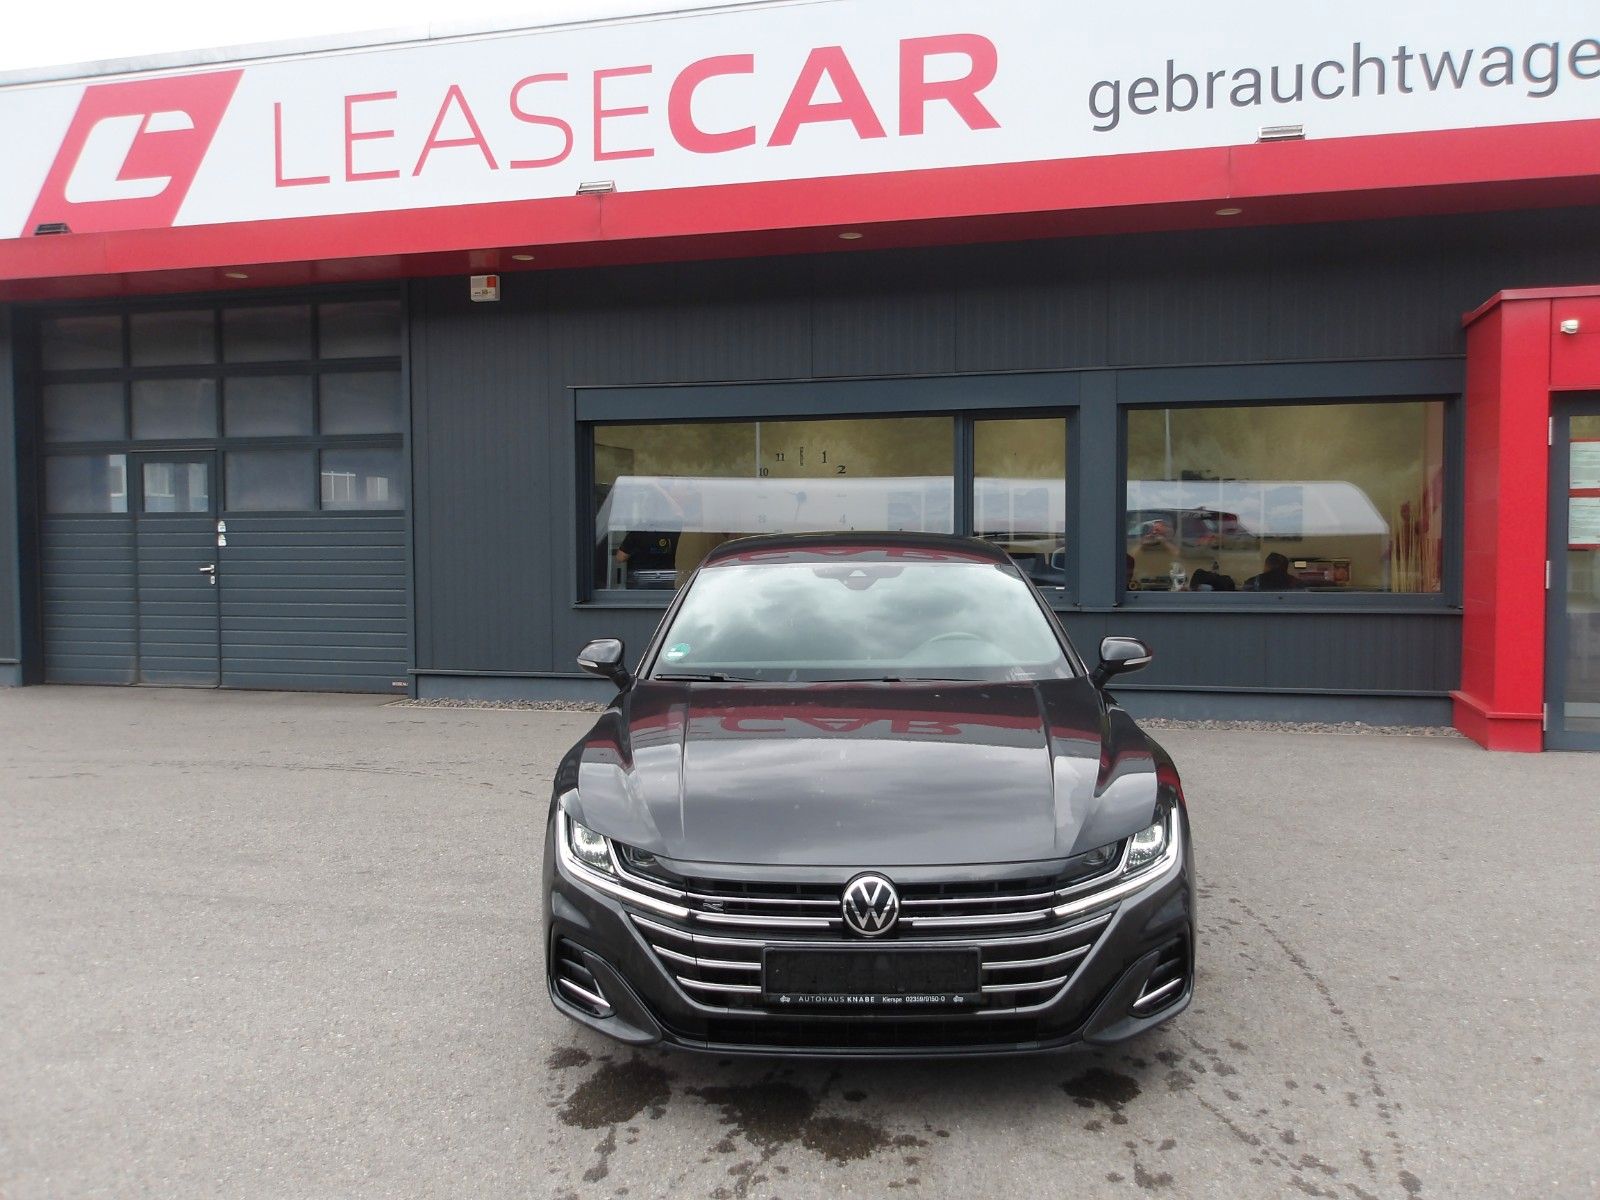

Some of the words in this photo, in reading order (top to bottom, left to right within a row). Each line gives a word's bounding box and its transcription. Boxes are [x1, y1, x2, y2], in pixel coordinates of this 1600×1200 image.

[274, 34, 1001, 188] LEASECAR
[1089, 38, 1600, 131] gebrauchtwage
[798, 995, 845, 1003] AUTOHAUS
[847, 995, 875, 1003] KNABE
